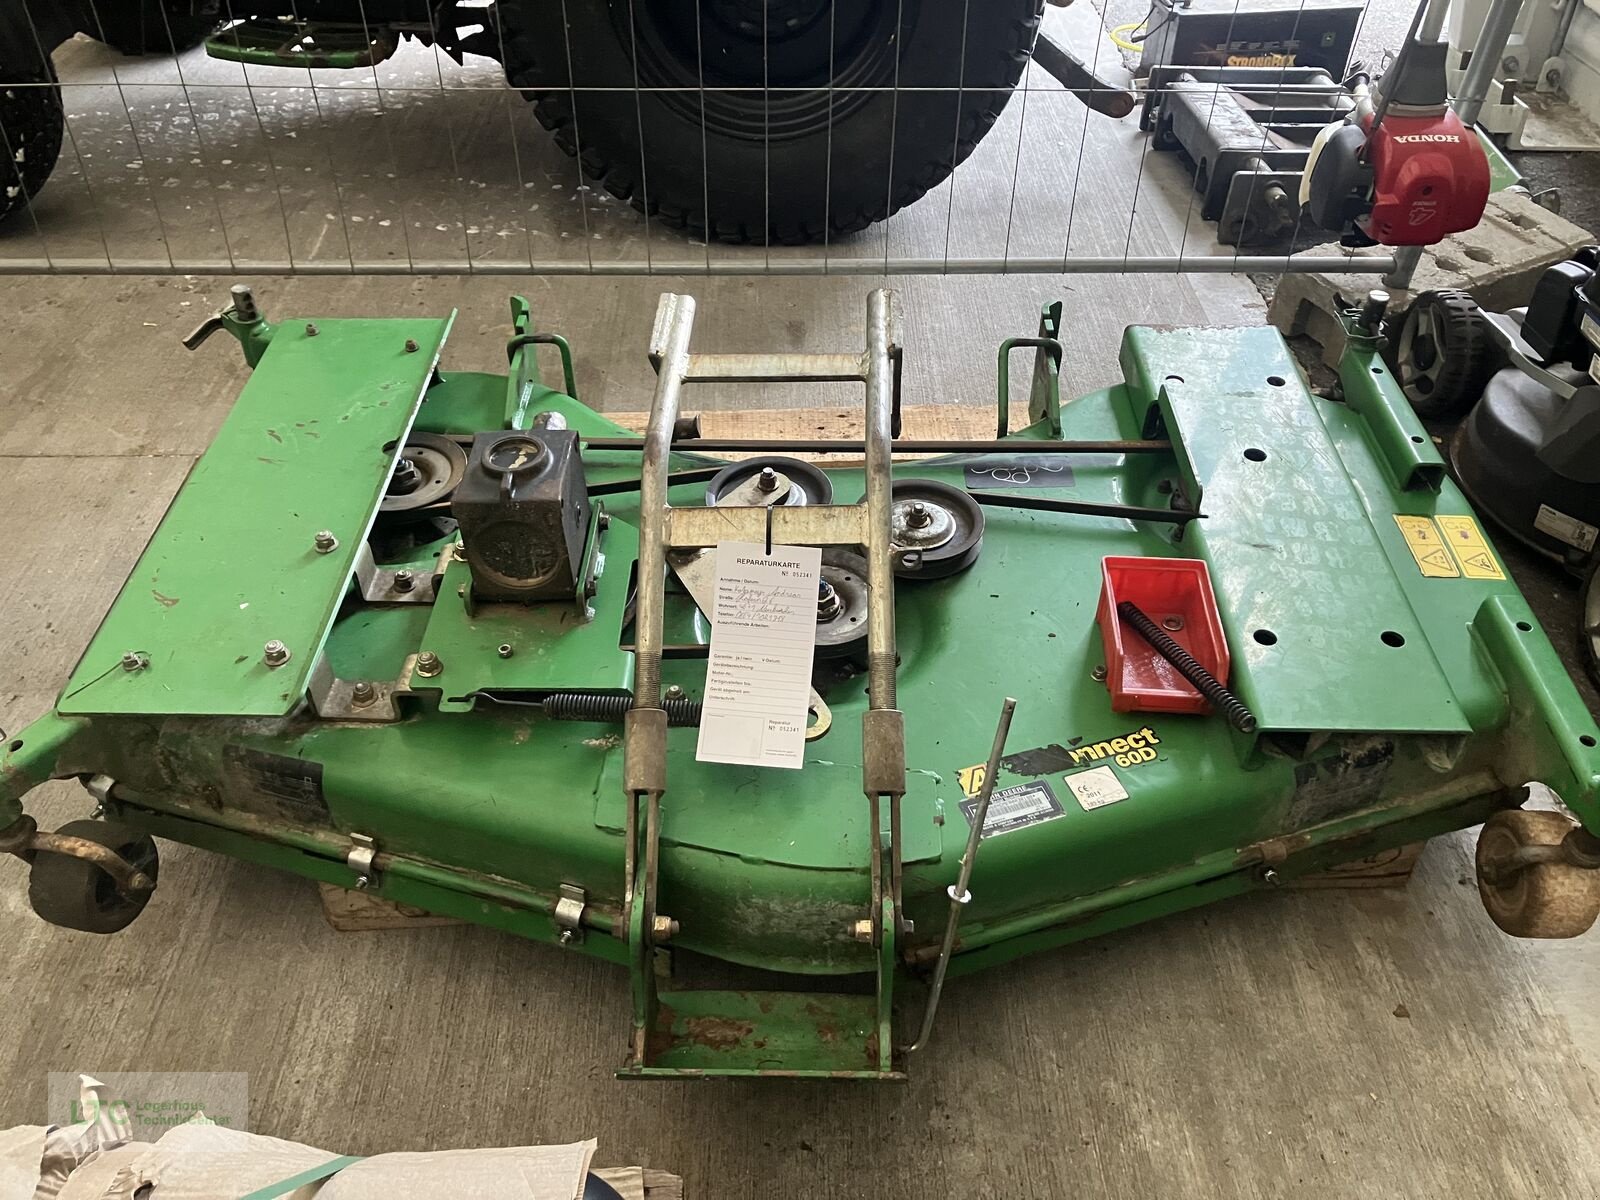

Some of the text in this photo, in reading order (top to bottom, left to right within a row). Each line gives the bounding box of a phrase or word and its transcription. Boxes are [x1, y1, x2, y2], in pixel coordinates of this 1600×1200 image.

[1393, 134, 1460, 144] HONDA
[736, 558, 801, 569] REPARATURKARTE
[1115, 747, 1157, 768] 60D
[1002, 786, 1027, 798] DEERE
